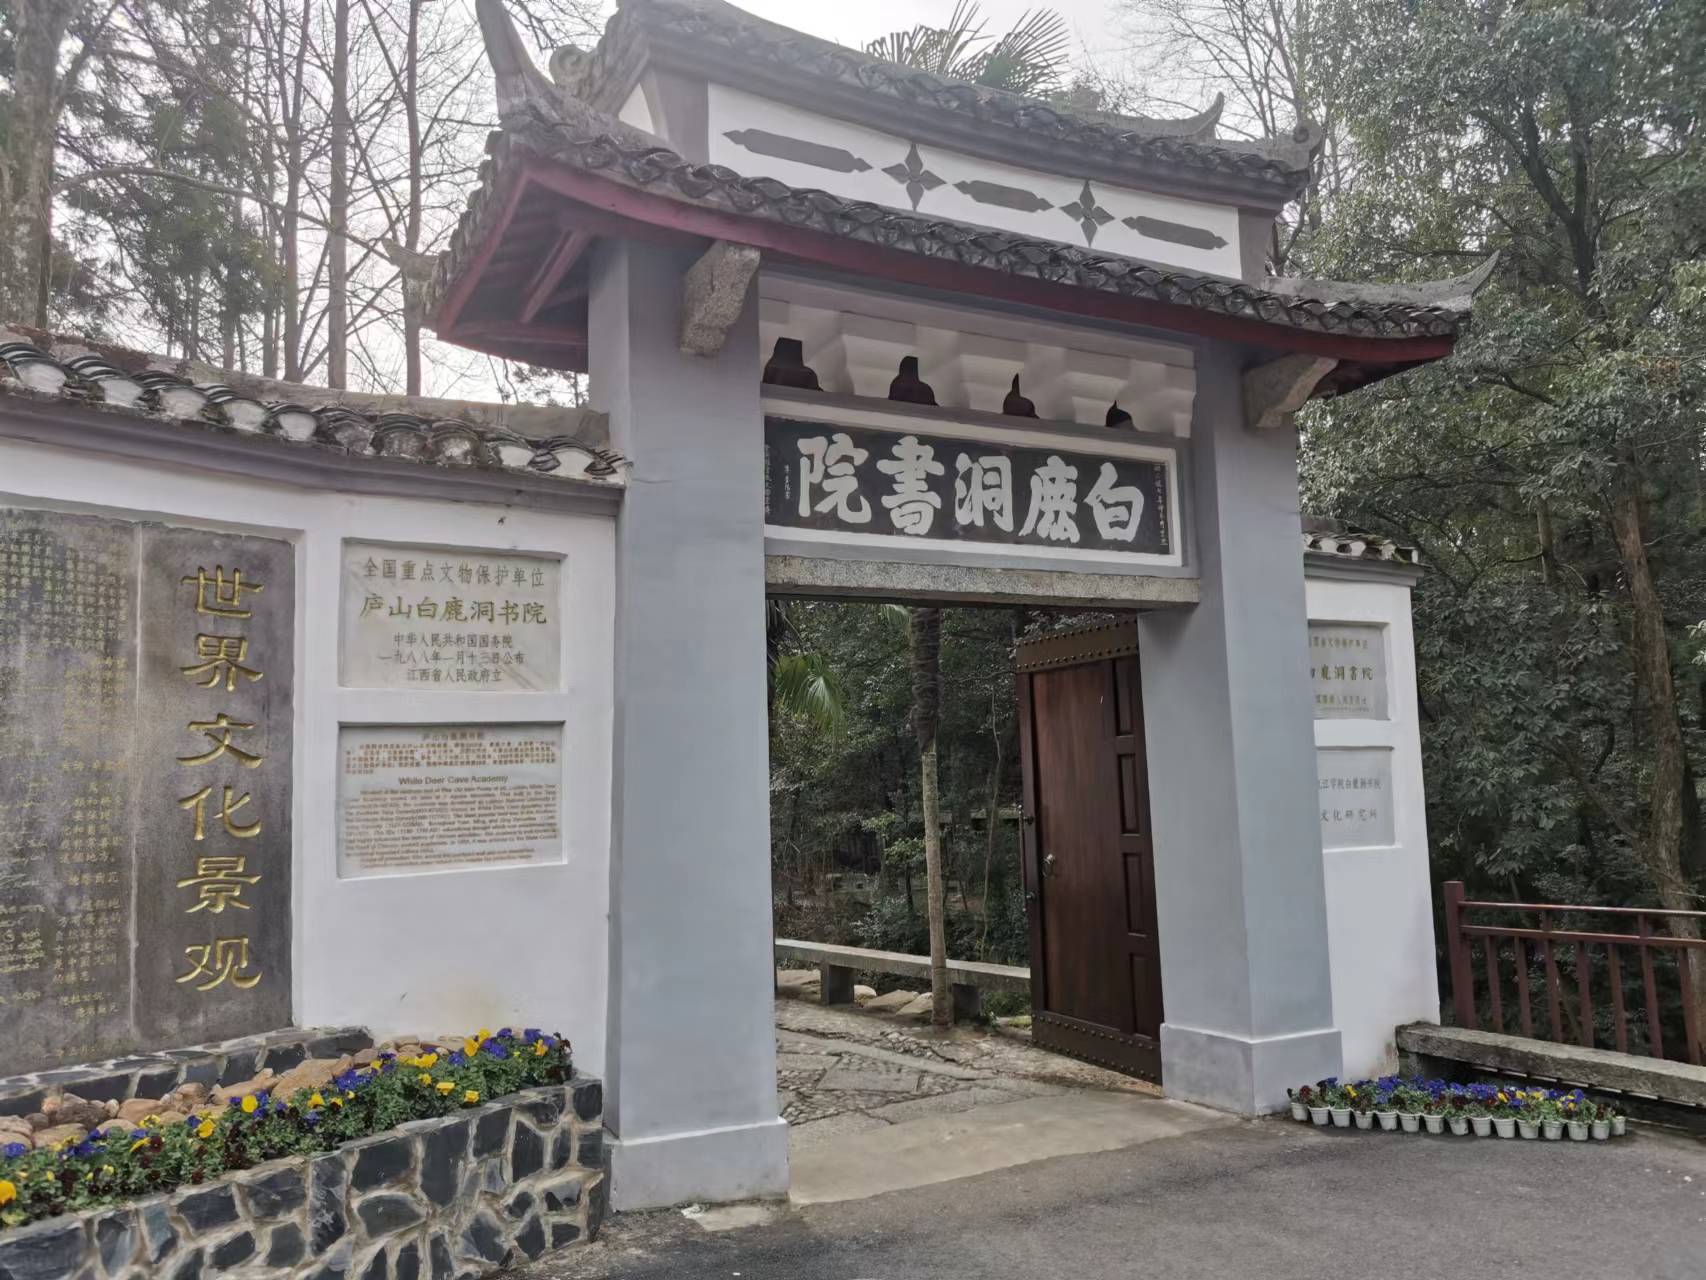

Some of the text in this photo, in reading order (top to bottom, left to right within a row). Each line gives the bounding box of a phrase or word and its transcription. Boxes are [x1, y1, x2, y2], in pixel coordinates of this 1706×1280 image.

[363, 556, 545, 588] 全国重点文物保护单位
[360, 593, 547, 625] 庐山白鹿洞书院
[393, 631, 514, 649] 中华人民共和国国务院
[407, 667, 503, 683] 江西省人民政府立
[175, 564, 265, 992] 世界文化景观
[399, 774, 508, 785] White Deer Cave Academy
